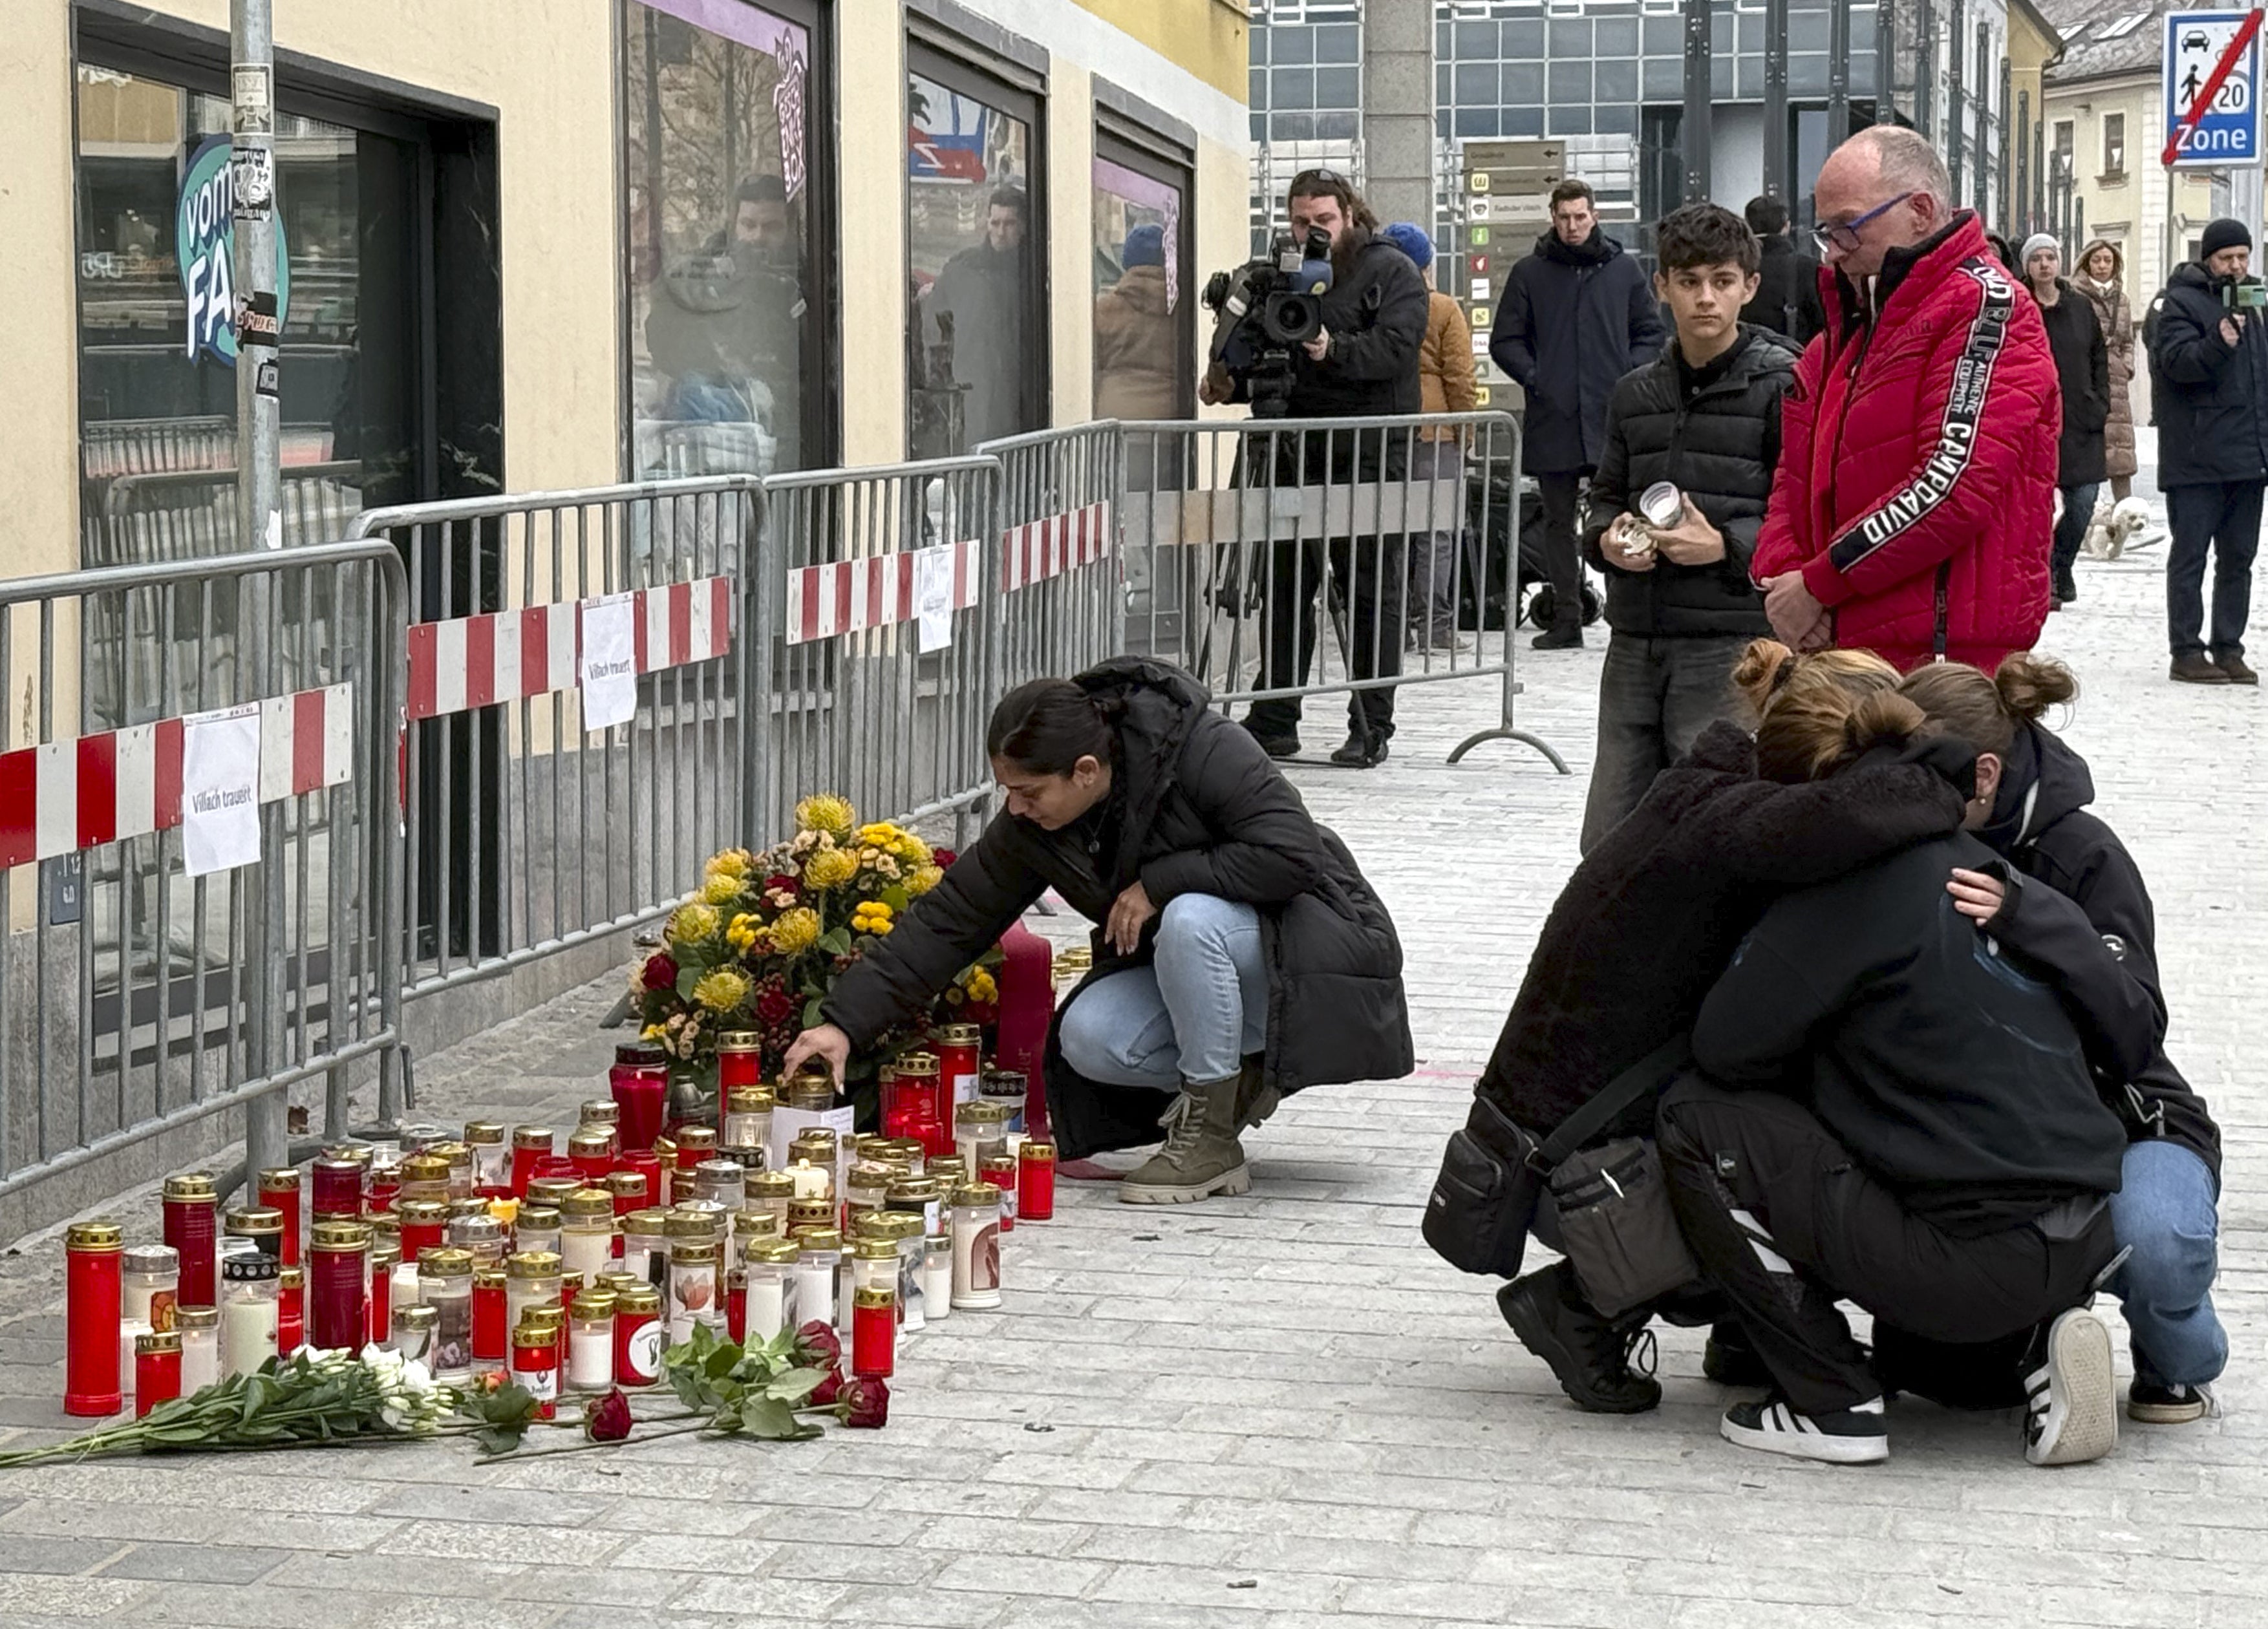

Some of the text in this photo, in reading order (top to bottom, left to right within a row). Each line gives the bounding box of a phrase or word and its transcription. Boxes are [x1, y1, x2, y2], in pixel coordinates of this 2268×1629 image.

[2218, 84, 2244, 108] 20
[2176, 124, 2247, 151] Zone
[187, 237, 237, 359] FA
[192, 783, 252, 814] Villach trauert
